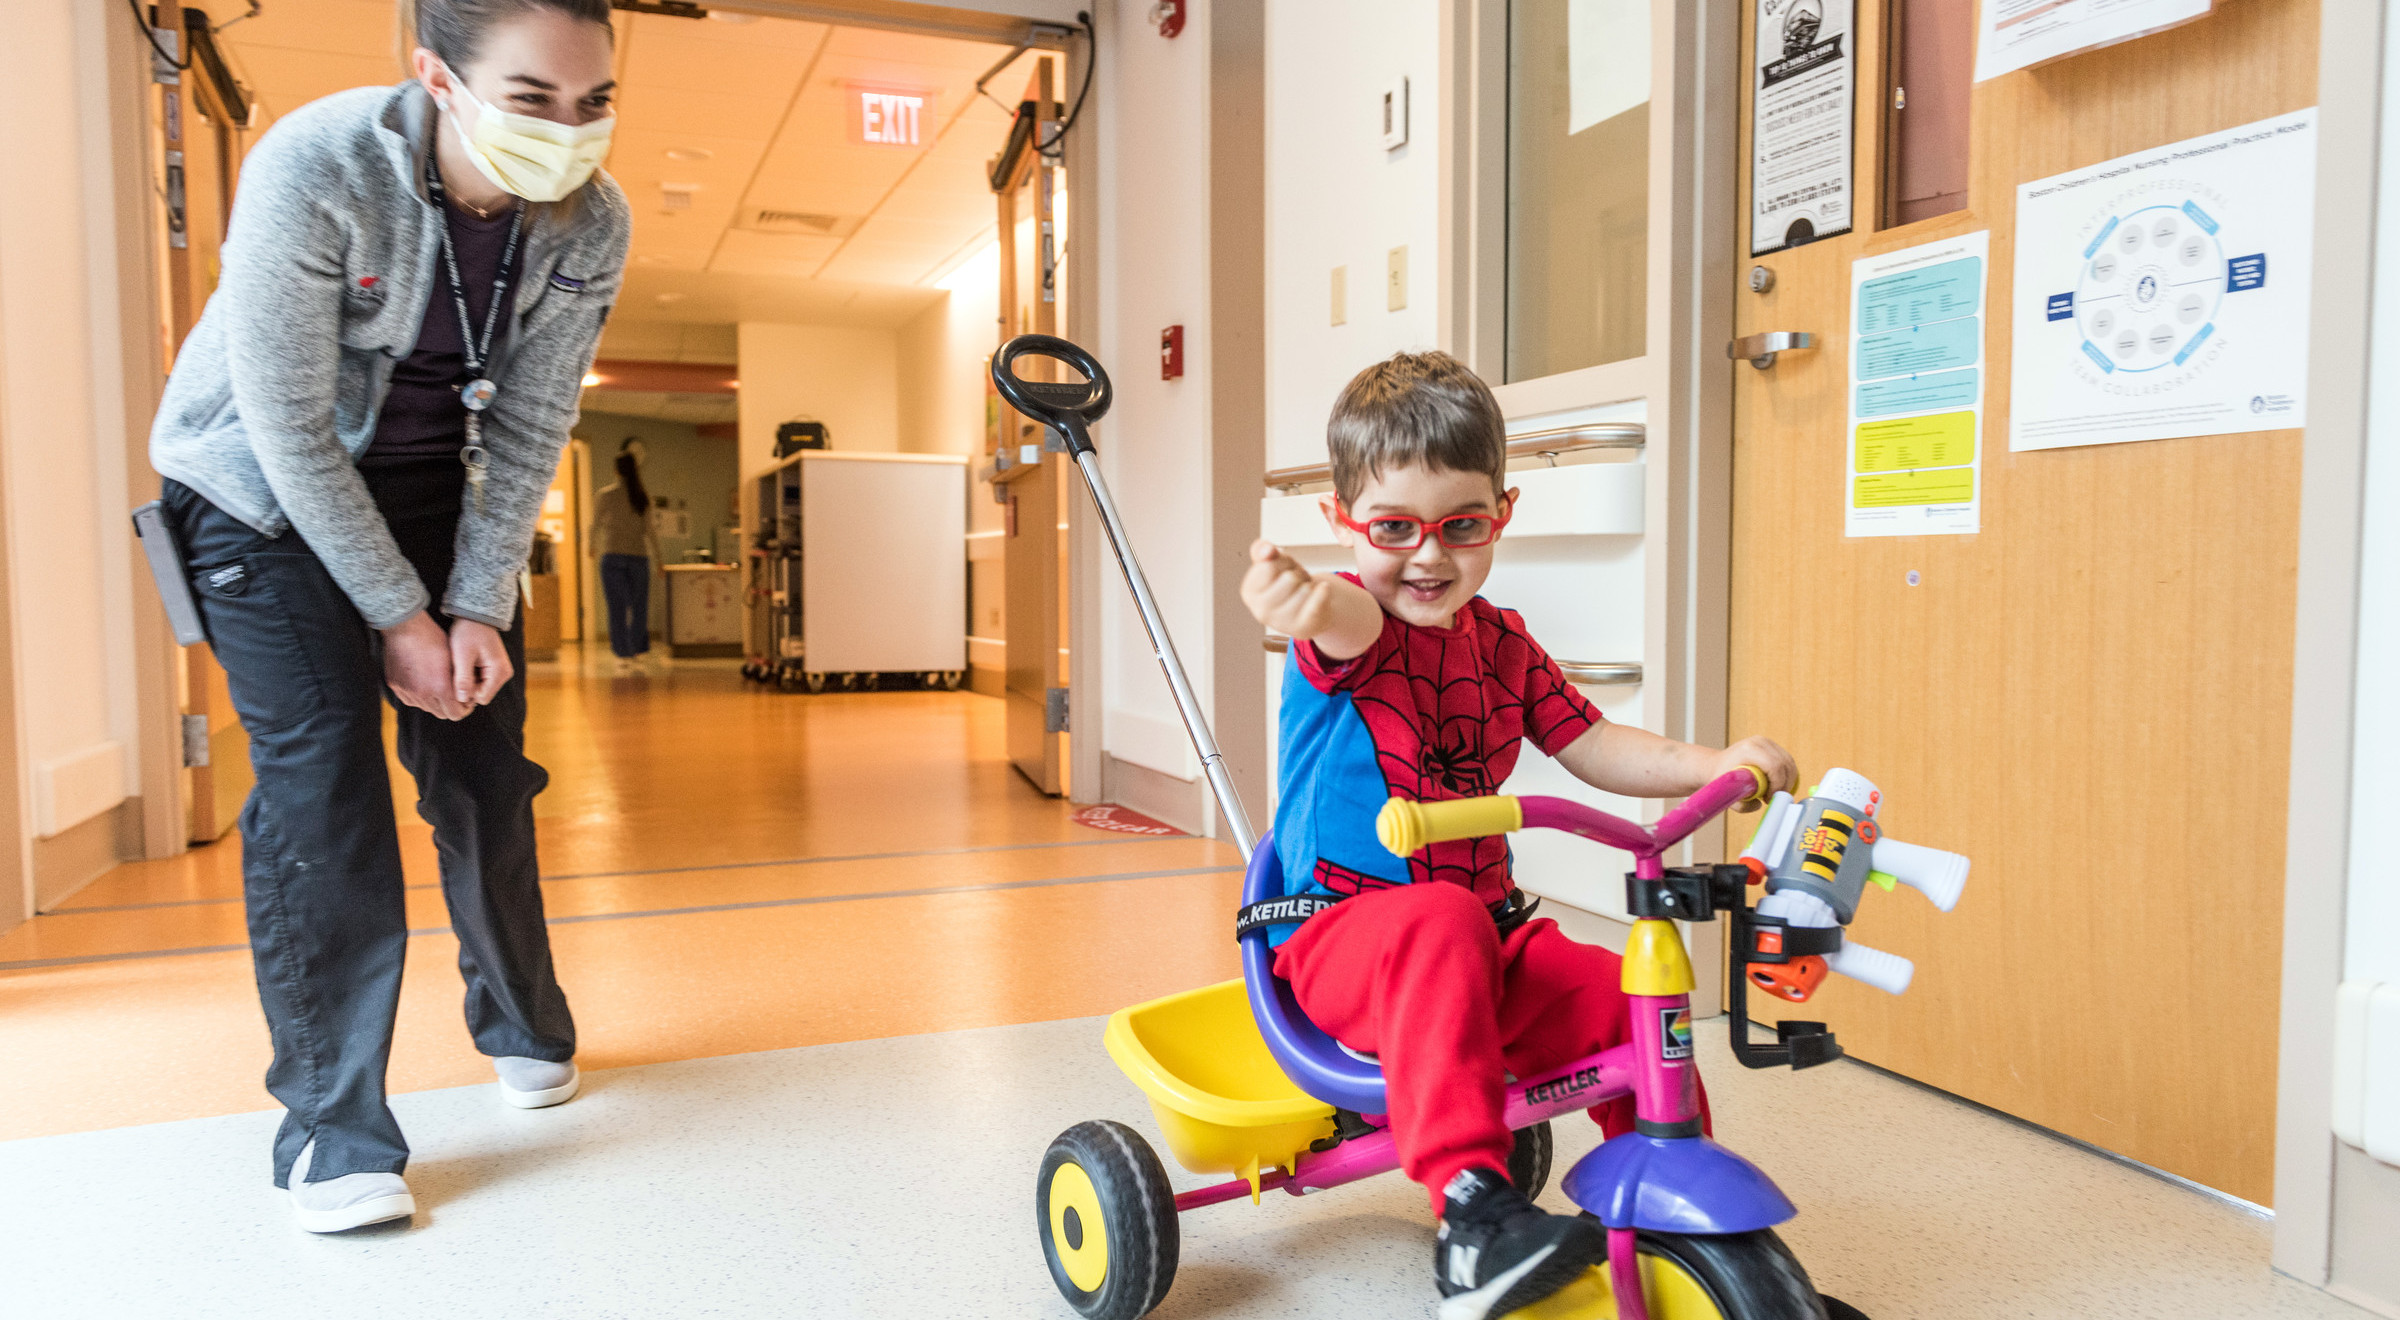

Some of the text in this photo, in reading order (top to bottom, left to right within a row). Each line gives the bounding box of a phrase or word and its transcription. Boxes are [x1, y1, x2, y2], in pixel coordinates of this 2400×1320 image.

[862, 92, 924, 146] EXIT
[1798, 826, 1819, 851] TOY
[1824, 837, 1840, 852] 4
[1525, 1066, 1602, 1106] KETTLER
